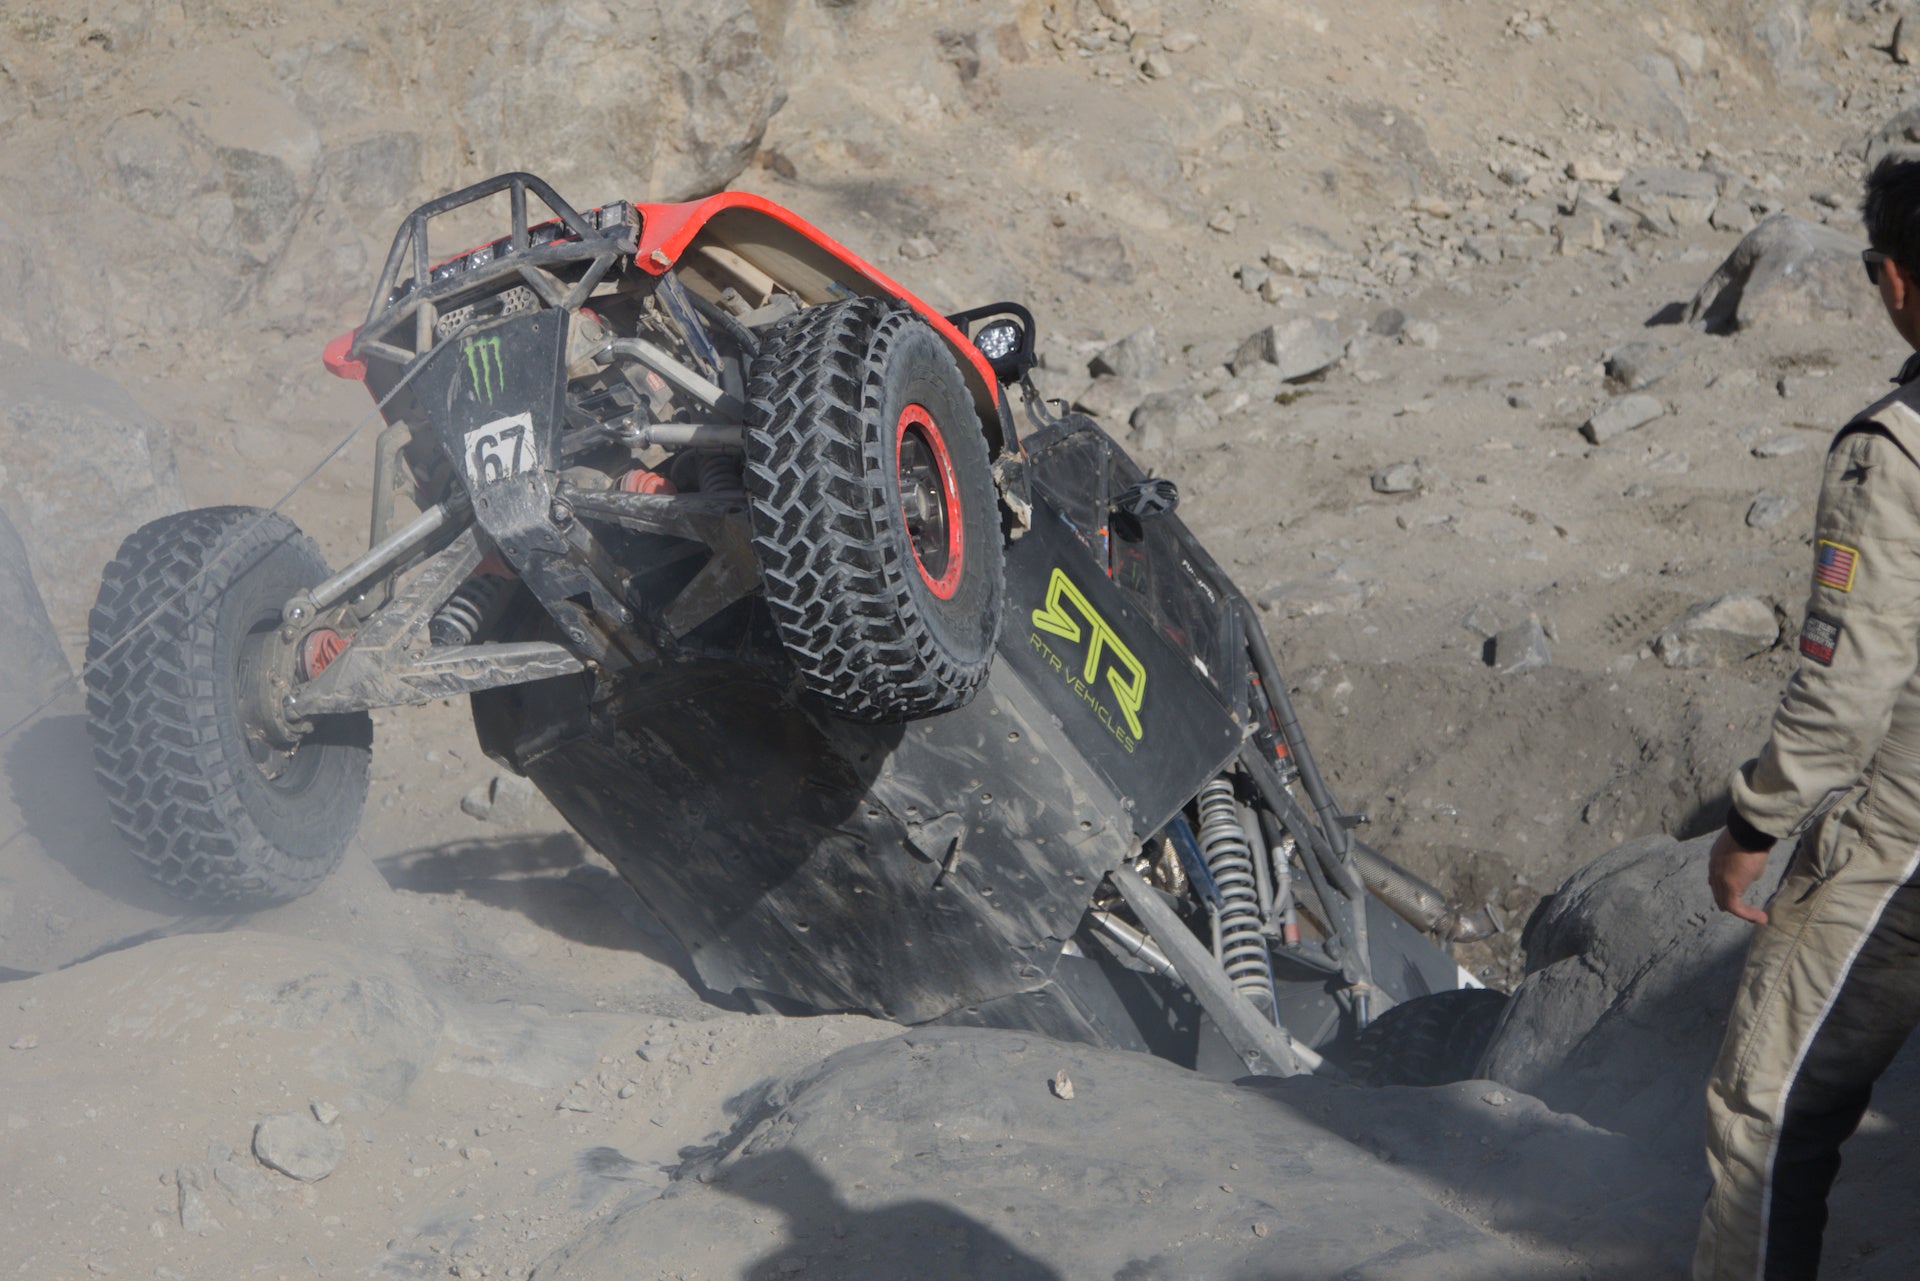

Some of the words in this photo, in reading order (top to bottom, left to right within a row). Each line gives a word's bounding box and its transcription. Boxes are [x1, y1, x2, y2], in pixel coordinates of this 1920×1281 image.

[475, 424, 526, 485] 67
[1030, 632, 1063, 673] RTR
[1065, 668, 1134, 753] VEHICLES
